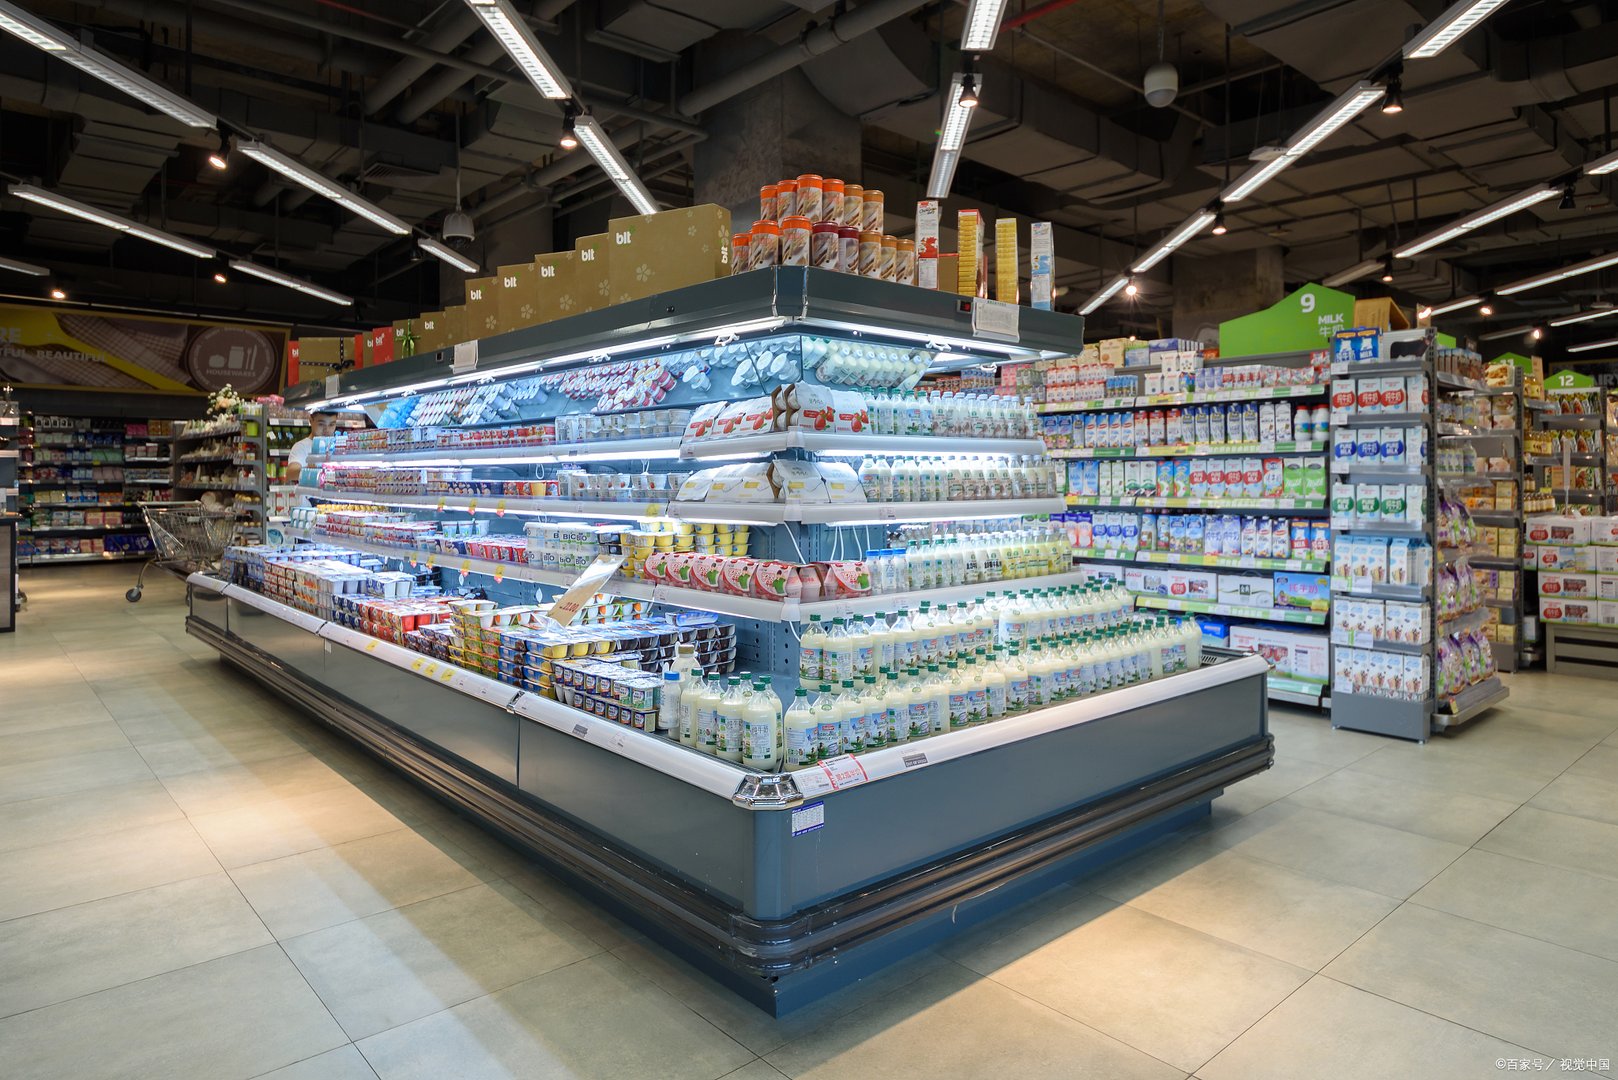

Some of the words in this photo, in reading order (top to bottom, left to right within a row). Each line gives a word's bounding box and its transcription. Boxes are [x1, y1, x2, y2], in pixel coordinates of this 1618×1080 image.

[1300, 293, 1315, 312] 9
[1318, 313, 1344, 325] MILK
[1559, 375, 1574, 386] 12
[1289, 584, 1319, 594] 纯牛奶
